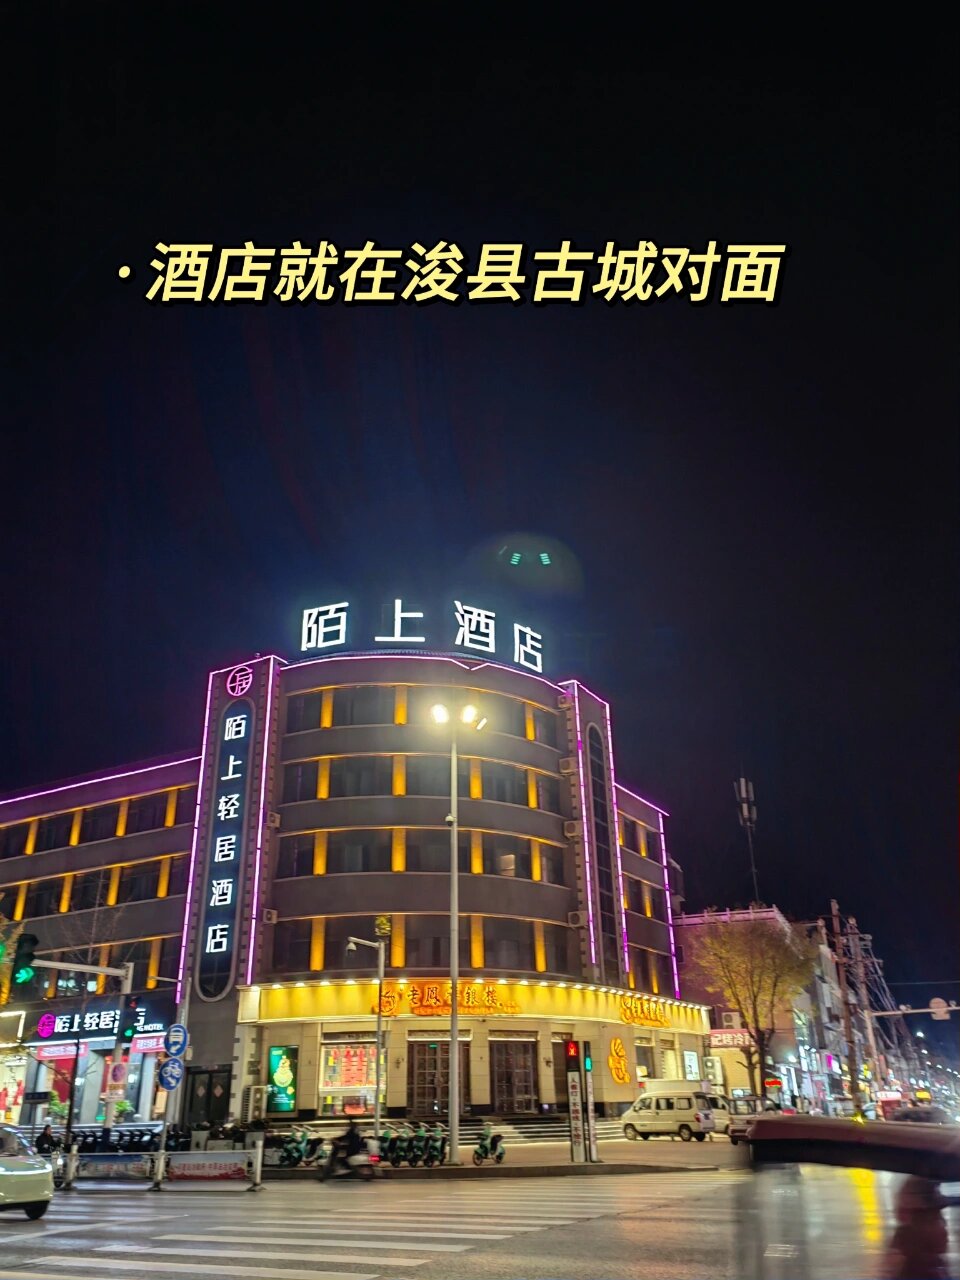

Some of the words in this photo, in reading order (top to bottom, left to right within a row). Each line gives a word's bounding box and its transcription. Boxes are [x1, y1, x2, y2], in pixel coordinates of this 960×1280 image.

[301, 599, 543, 673] 陌上酒店
[204, 714, 248, 953] 陌上轻居酒店
